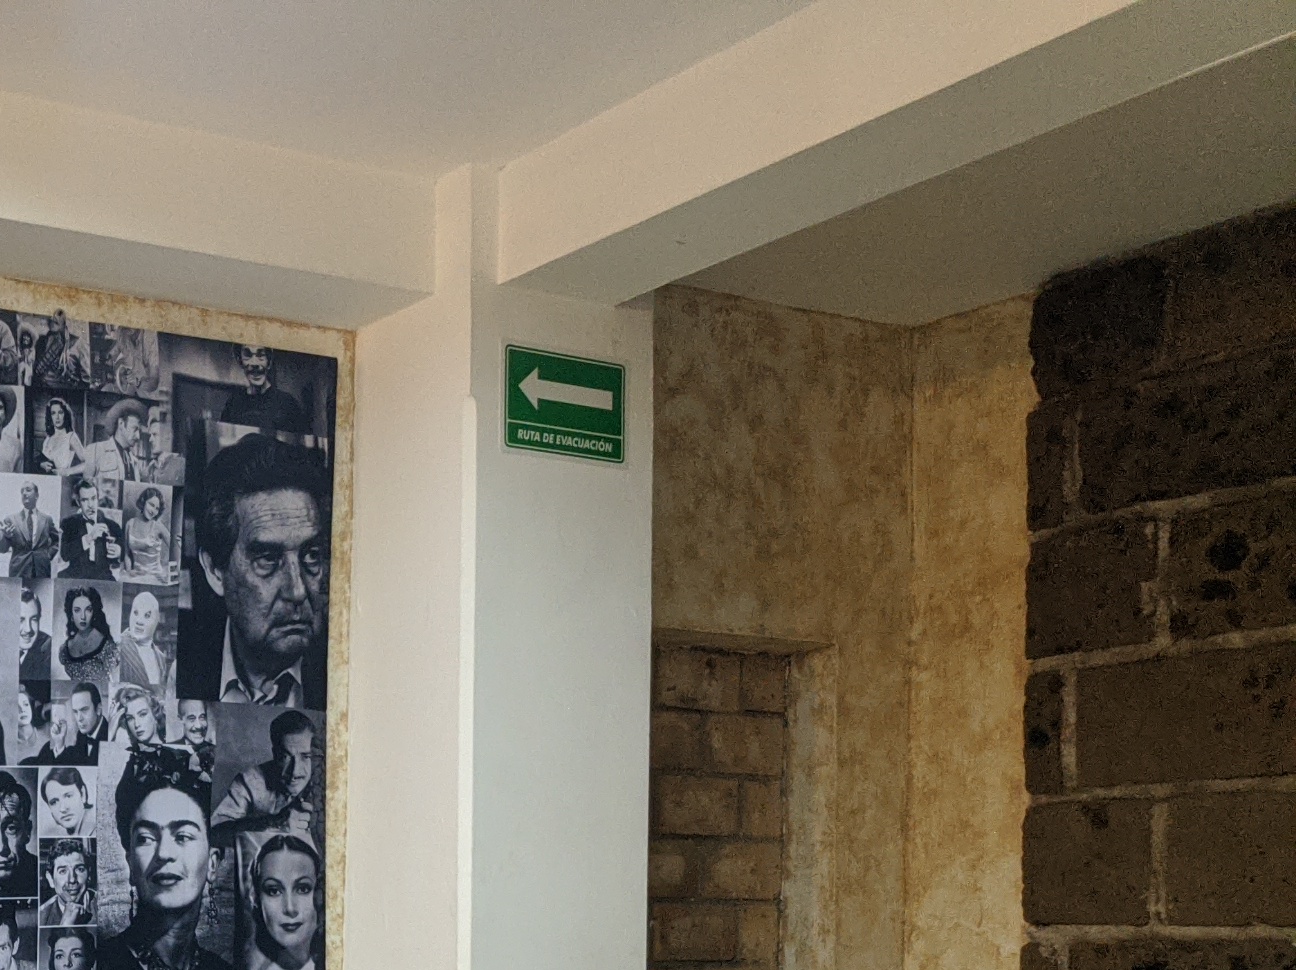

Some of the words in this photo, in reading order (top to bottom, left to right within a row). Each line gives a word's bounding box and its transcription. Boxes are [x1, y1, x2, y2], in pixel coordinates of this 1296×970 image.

[517, 429, 540, 442] RUTA
[543, 432, 555, 444] DE
[556, 434, 612, 452] EVACUACIÓN
